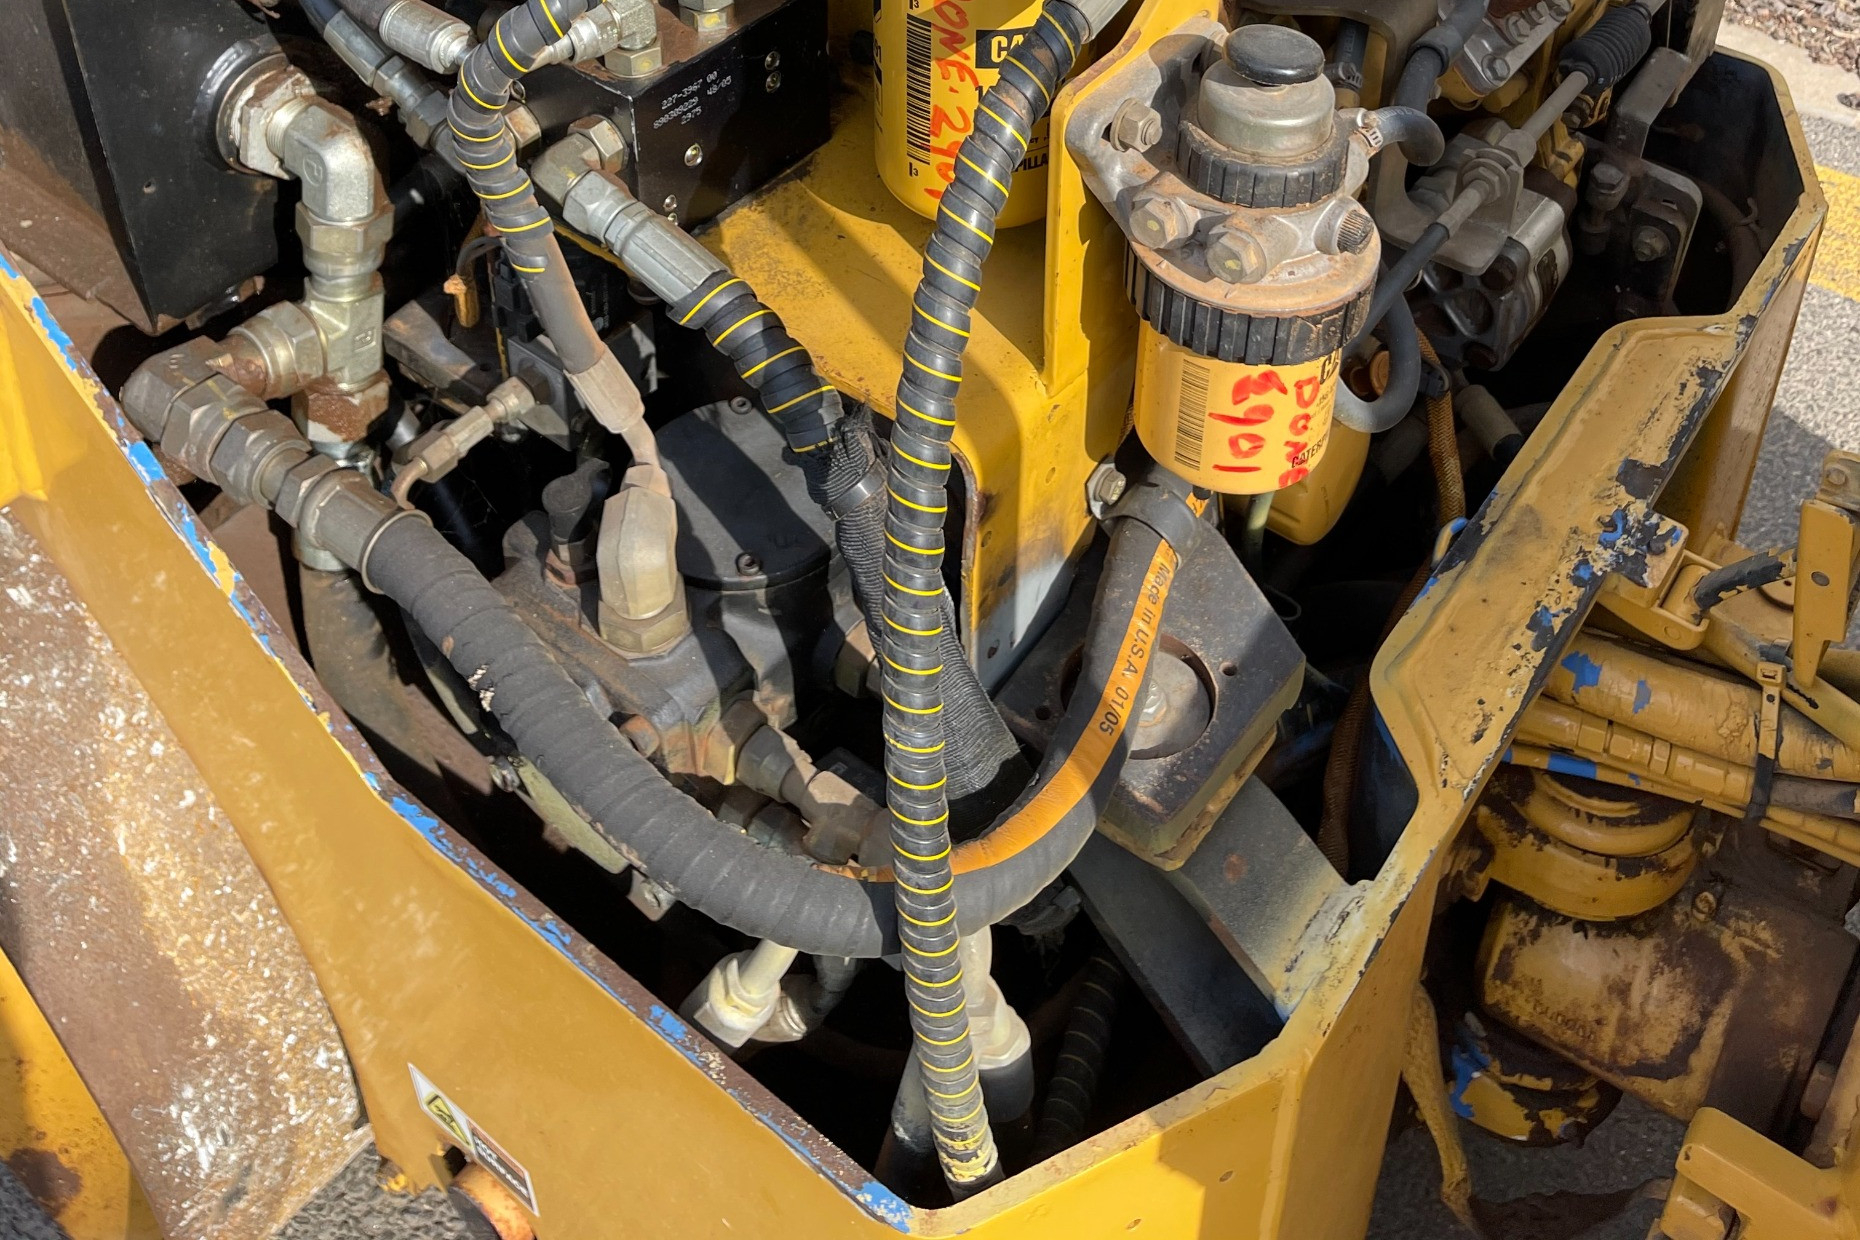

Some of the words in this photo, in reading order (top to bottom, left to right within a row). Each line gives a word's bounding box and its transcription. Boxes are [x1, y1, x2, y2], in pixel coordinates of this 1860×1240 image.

[1147, 562, 1171, 605] Made
[1140, 605, 1157, 624] in
[1099, 684, 1130, 737] 01/05
